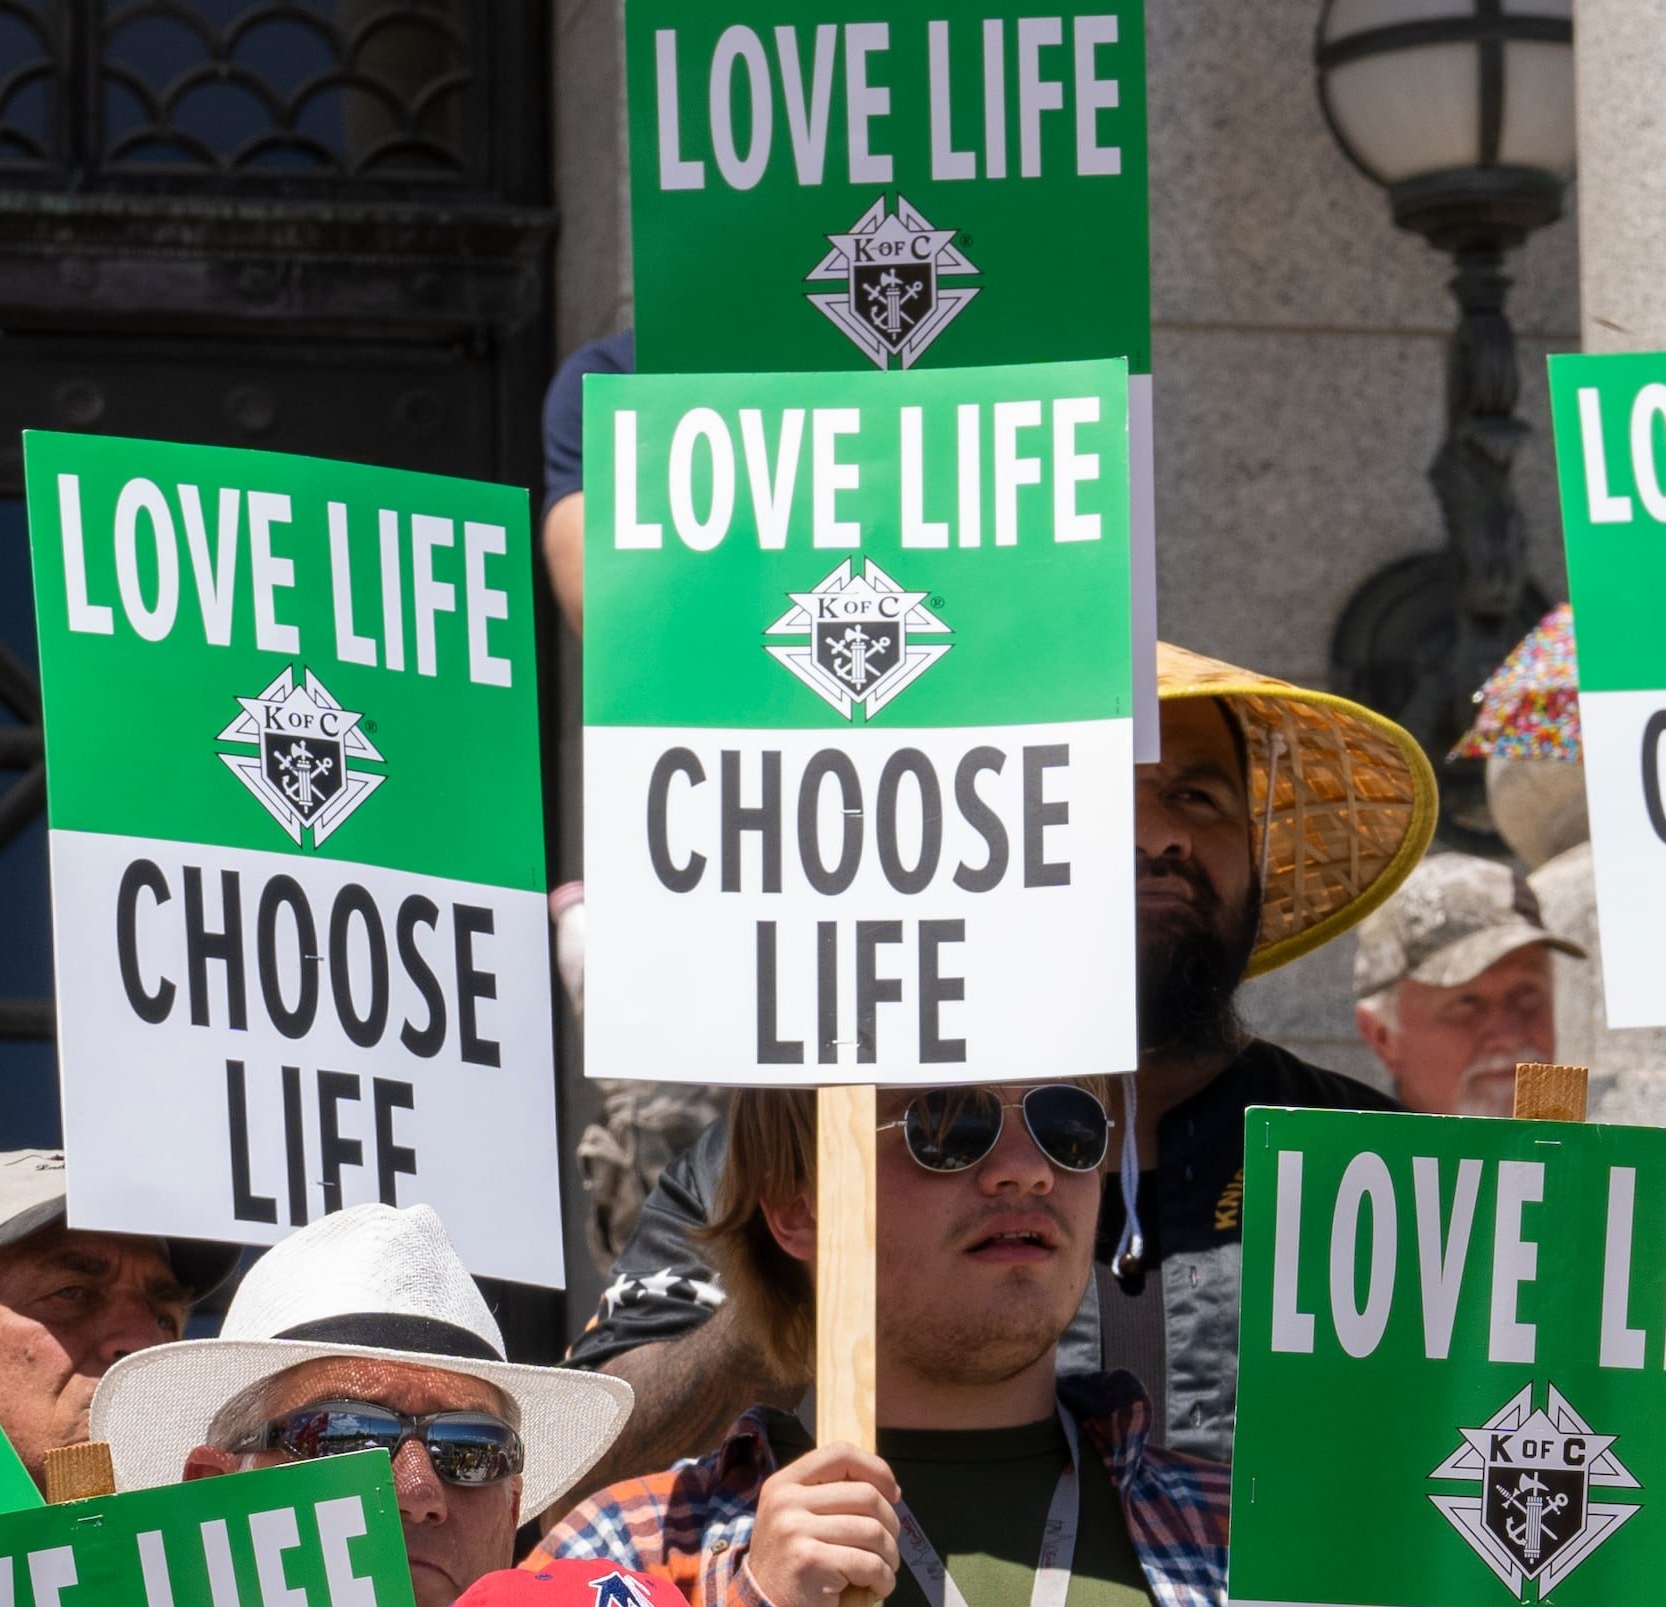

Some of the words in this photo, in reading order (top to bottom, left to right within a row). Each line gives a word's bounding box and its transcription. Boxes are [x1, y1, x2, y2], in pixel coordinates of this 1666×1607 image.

[655, 23, 893, 190] LOVE
[929, 14, 1121, 180] LIFE
[853, 238, 874, 263] K
[878, 241, 905, 257] OF
[910, 234, 932, 260] C
[614, 407, 860, 551] LOVE
[900, 396, 1101, 549] LIFE
[57, 473, 301, 655] LOVE
[327, 501, 513, 688] LIFE
[817, 597, 838, 619] K
[843, 602, 872, 615] OF
[877, 595, 900, 618] C
[263, 705, 286, 730] K
[287, 713, 314, 728] OF
[320, 712, 340, 738] C
[646, 743, 1071, 896] CHOOSE
[117, 858, 501, 1068] CHOOSE
[756, 918, 967, 1065] LIFE
[225, 1060, 418, 1227] LIFE
[1270, 1150, 1546, 1363] LOVE
[1488, 1434, 1512, 1464] K
[1521, 1440, 1554, 1459] OF
[1561, 1436, 1587, 1467] C
